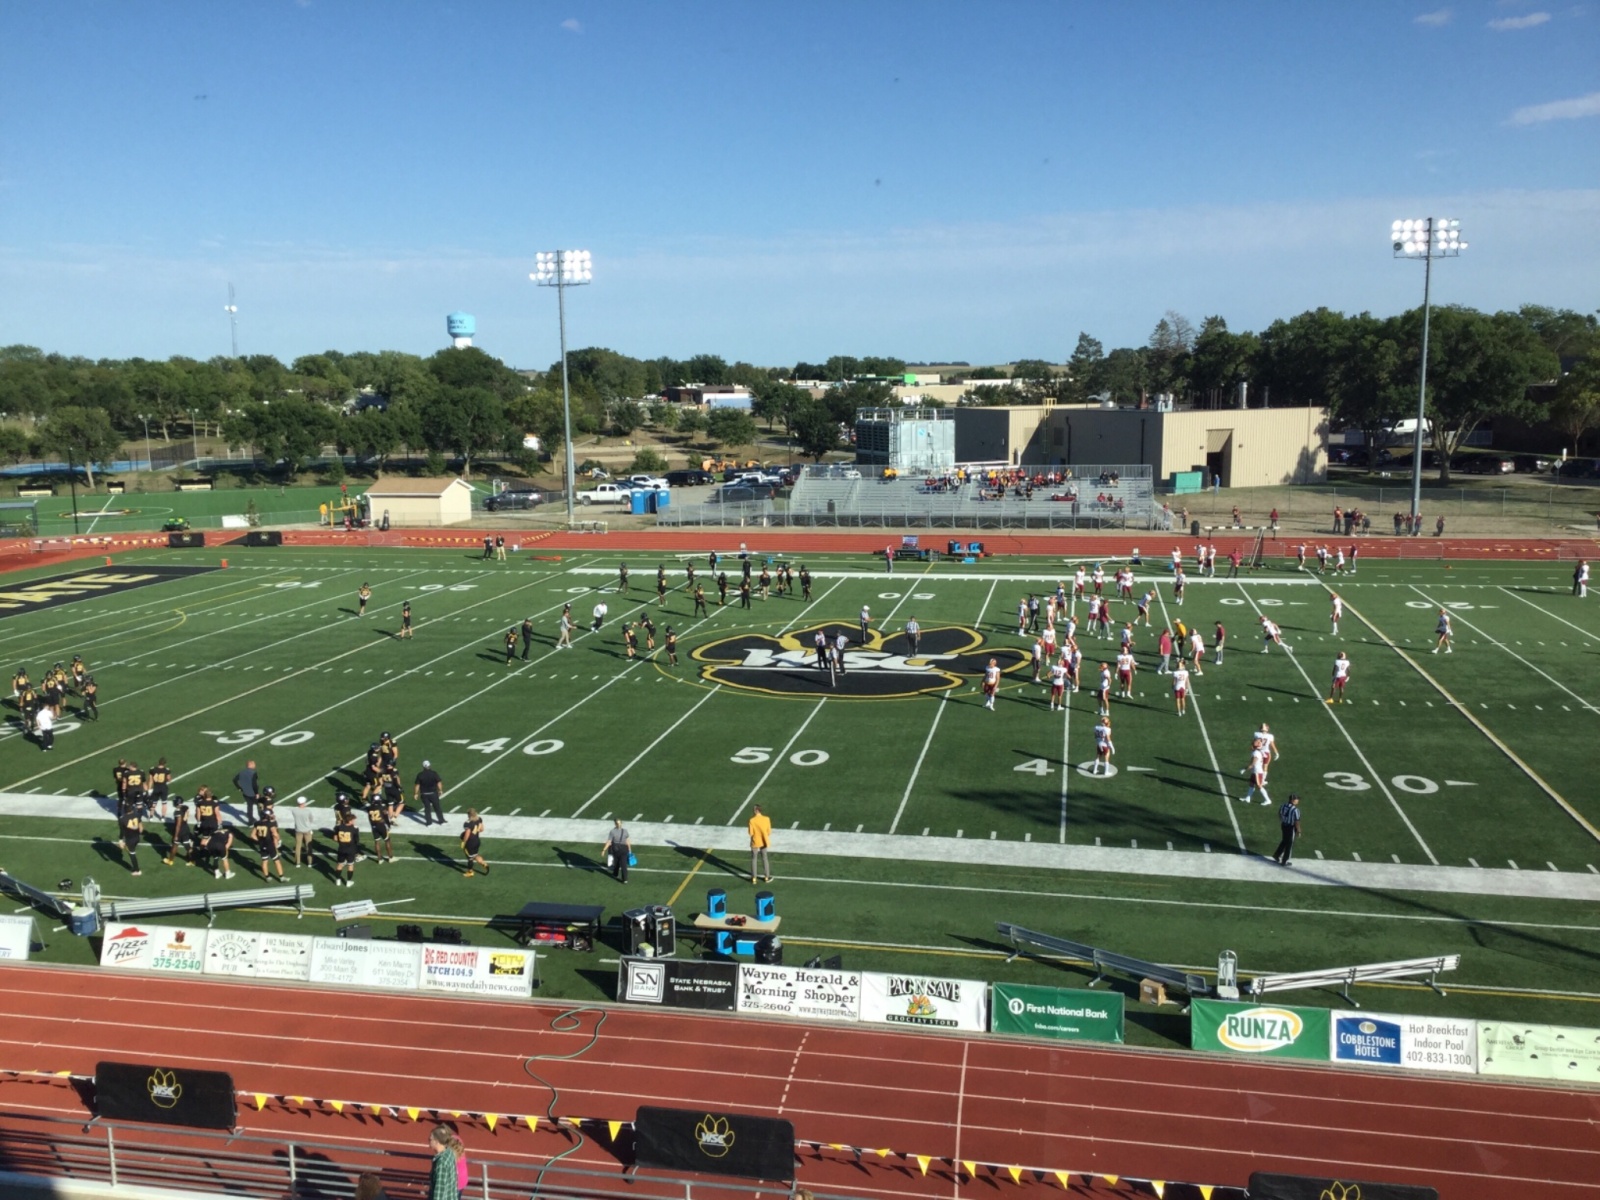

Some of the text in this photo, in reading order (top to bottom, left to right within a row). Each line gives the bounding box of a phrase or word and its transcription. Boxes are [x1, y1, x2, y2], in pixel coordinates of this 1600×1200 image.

[878, 592, 936, 600] 50
[1219, 598, 1284, 606] 30
[216, 728, 315, 746] 30
[466, 737, 565, 755] 40
[730, 746, 830, 766] 50
[1013, 758, 1118, 779] 40
[1323, 771, 1439, 794] 30
[107, 939, 148, 956] Pizza
[265, 938, 277, 946] 102
[278, 939, 295, 947] Main
[115, 948, 143, 960] Hut
[425, 948, 478, 968] BIG RED COUNTRY
[152, 957, 201, 971] 375-2540
[221, 963, 238, 972] PUB
[451, 967, 473, 977] 104.9
[742, 967, 859, 987] Wayne Herald &
[743, 983, 856, 1004] Morning Shopper
[926, 980, 961, 1003] SAVE
[741, 1000, 792, 1012] 375-2600
[1026, 1003, 1046, 1014] First
[1046, 1005, 1084, 1017] National
[1085, 1008, 1108, 1019] Bank
[887, 1014, 957, 1026] GROCERY STORE
[1227, 1016, 1292, 1042] RUNZA
[1409, 1024, 1469, 1037] Hot Breakfast
[1340, 1032, 1396, 1049] COBBLESTONE
[1414, 1038, 1464, 1051] Indoor Pool
[1354, 1045, 1381, 1058] HOTEL
[1406, 1051, 1472, 1066] 402-833-1300
[701, 1132, 726, 1144] WSC
